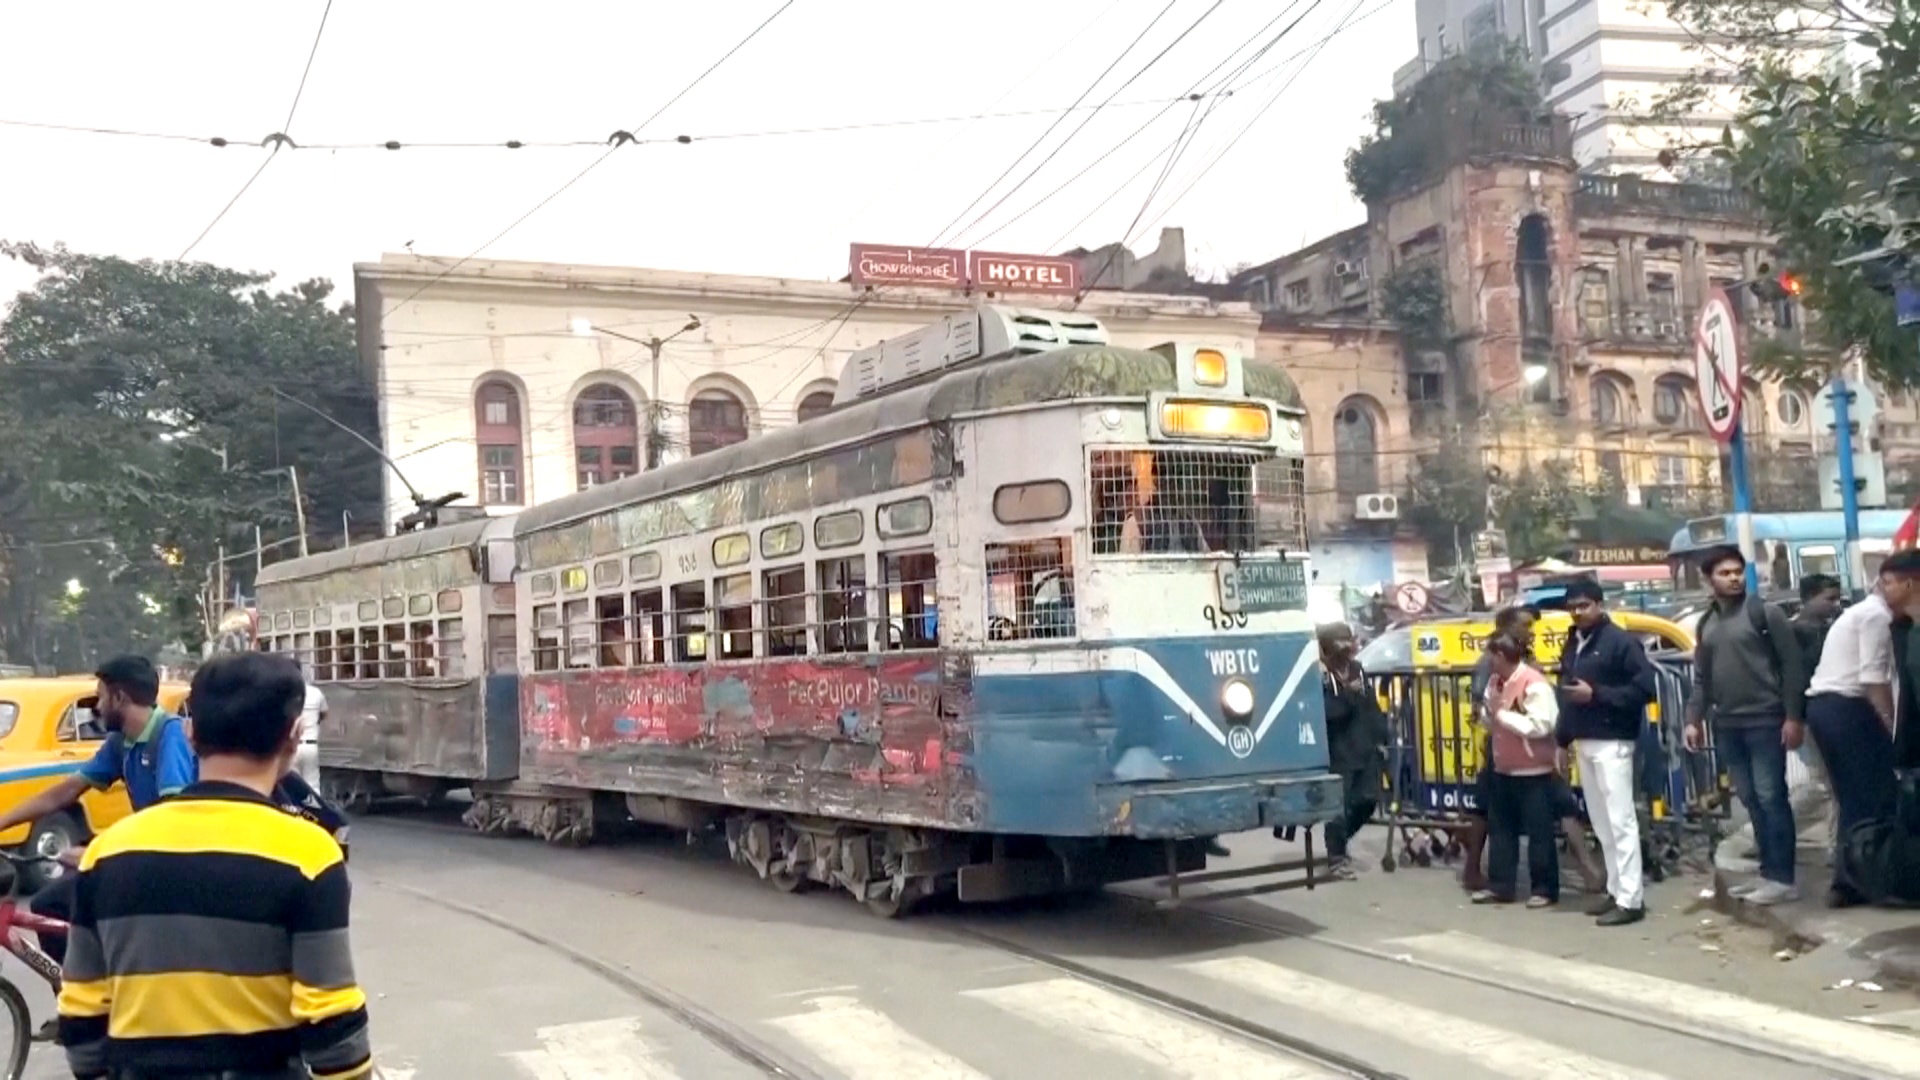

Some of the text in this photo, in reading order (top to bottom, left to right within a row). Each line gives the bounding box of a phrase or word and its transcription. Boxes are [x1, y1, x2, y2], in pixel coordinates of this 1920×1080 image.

[859, 257, 950, 279] CHOWRINGHEE
[988, 263, 1063, 283] HOTEL
[1578, 547, 1635, 563] ZEESHAN
[1237, 564, 1304, 583] ESPLANADE
[1209, 648, 1260, 675] WBTC
[1232, 731, 1250, 750] GH
[24, 946, 60, 977] HERO
